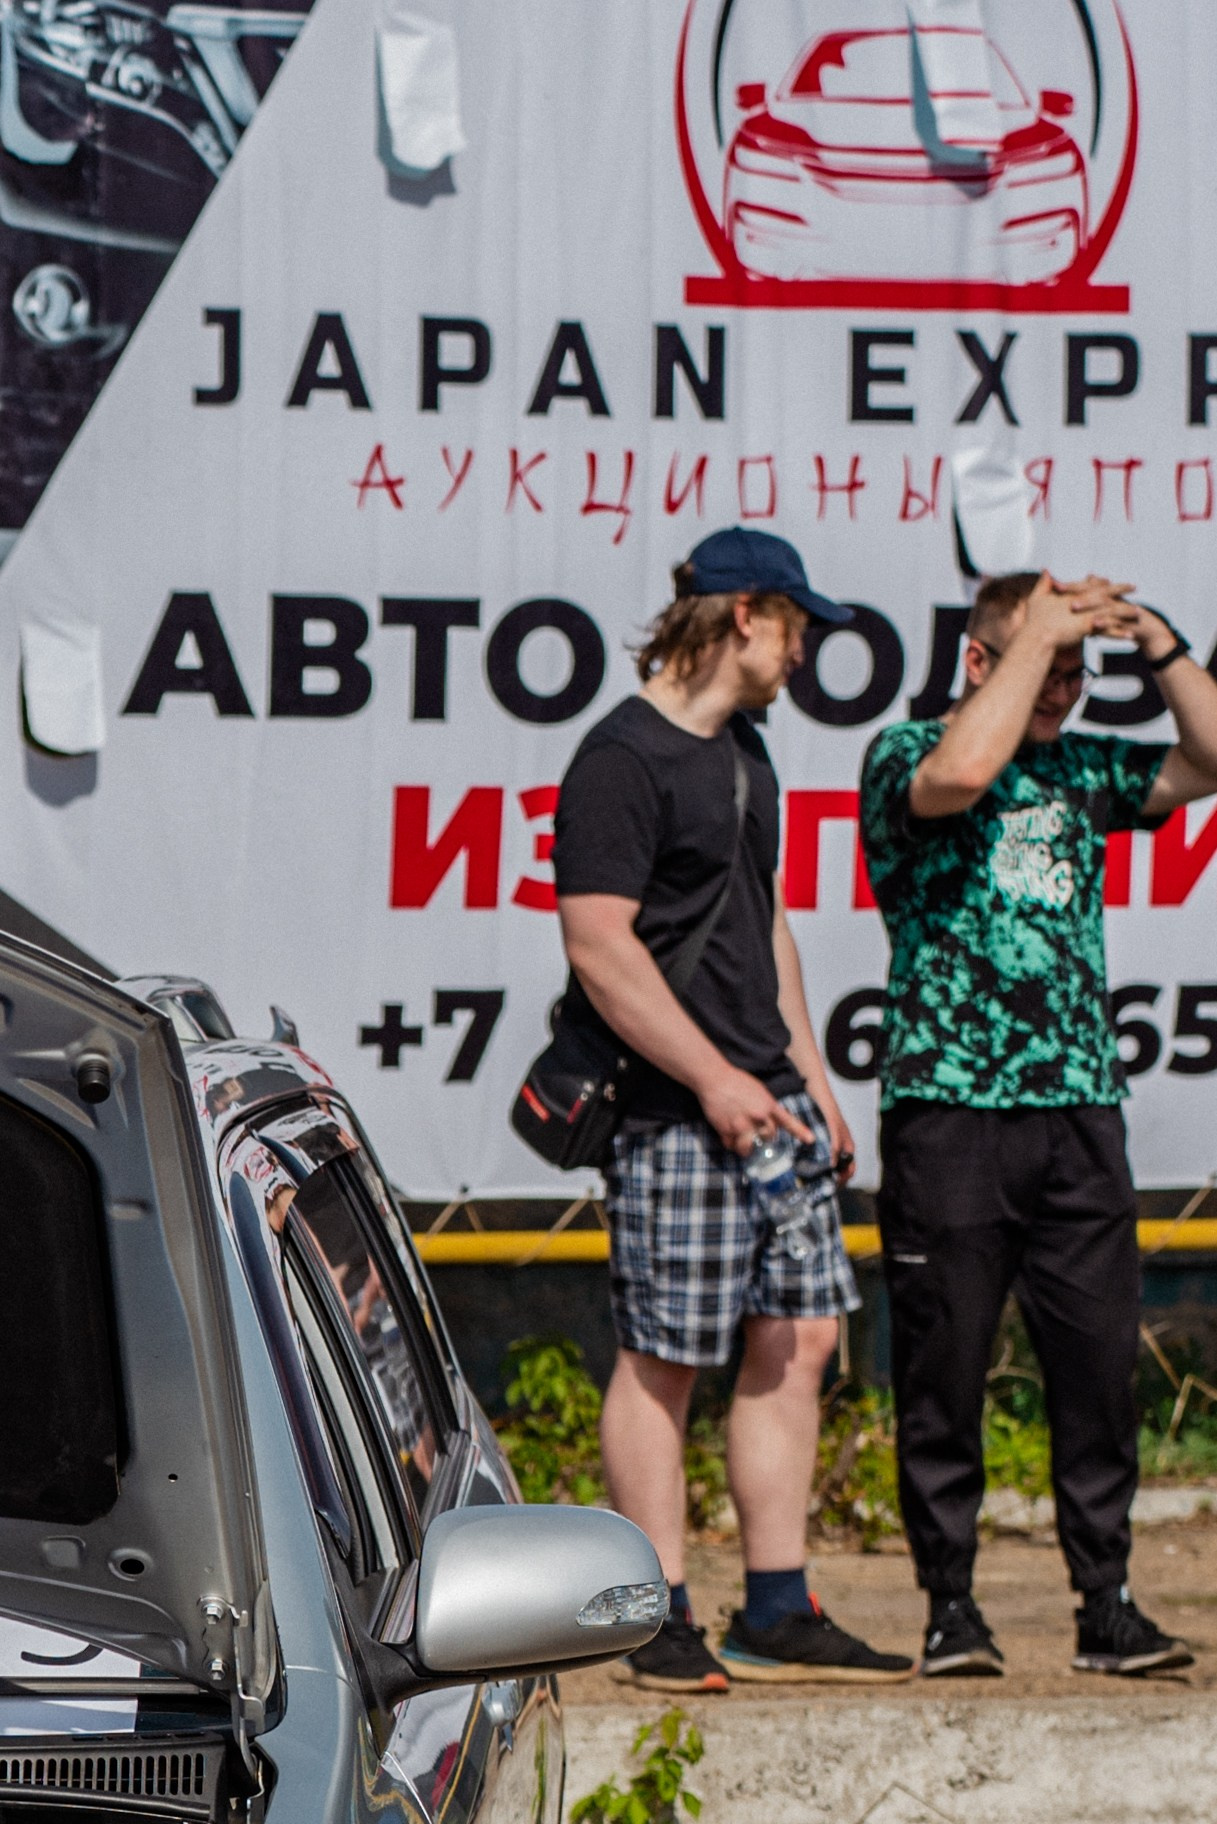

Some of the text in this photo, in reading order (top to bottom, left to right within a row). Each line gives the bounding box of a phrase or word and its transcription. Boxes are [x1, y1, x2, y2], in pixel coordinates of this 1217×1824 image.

[193, 307, 725, 420] JAPAN
[349, 443, 944, 546] АУКЦИОНЫ
[120, 591, 606, 725] АВТО
[359, 989, 505, 1083] +7
